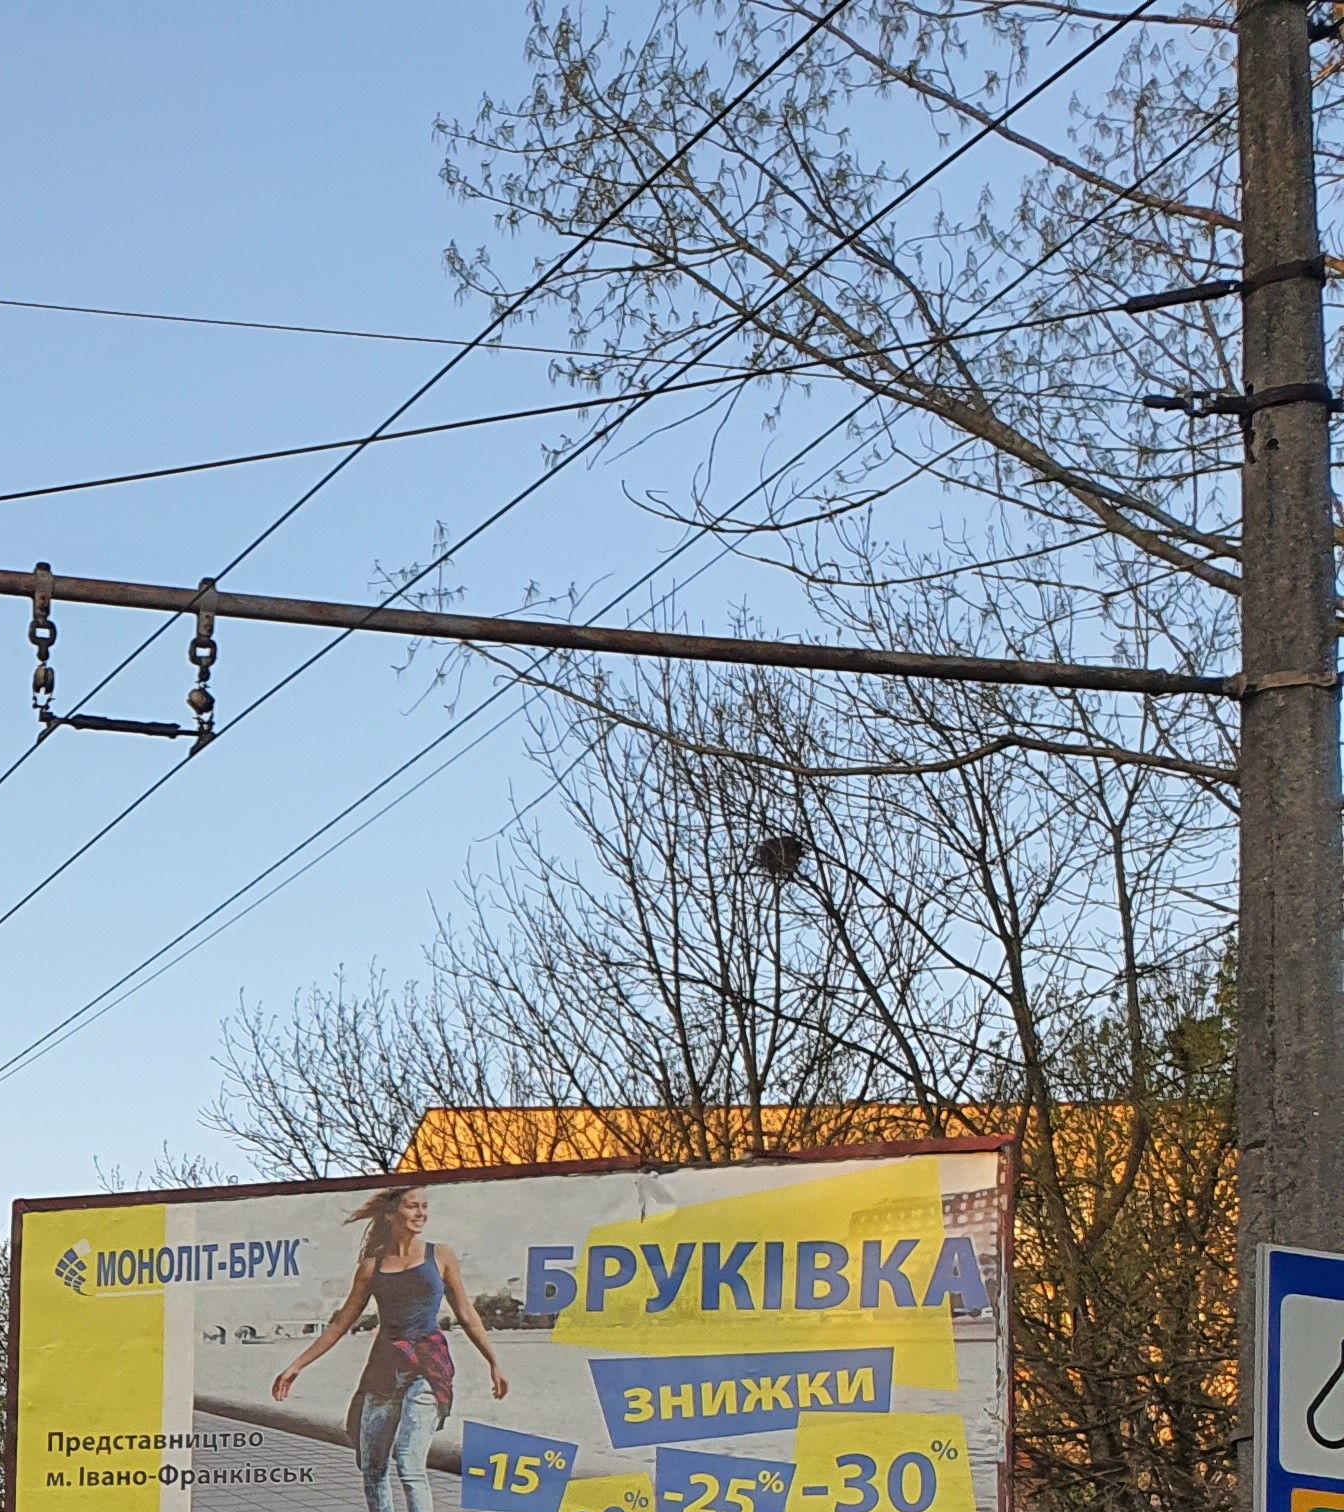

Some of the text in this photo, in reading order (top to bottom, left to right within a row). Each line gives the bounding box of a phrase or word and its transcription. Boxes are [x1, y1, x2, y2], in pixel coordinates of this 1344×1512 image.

[97, 1239, 300, 1287] МОНОЛІТ-БРУК
[525, 1237, 989, 1313] БРУКІВКА
[47, 1431, 263, 1457] Представництво
[46, 1462, 314, 1490] м. Івано-Франківськ
[468, 1450, 566, 1494] -15%
